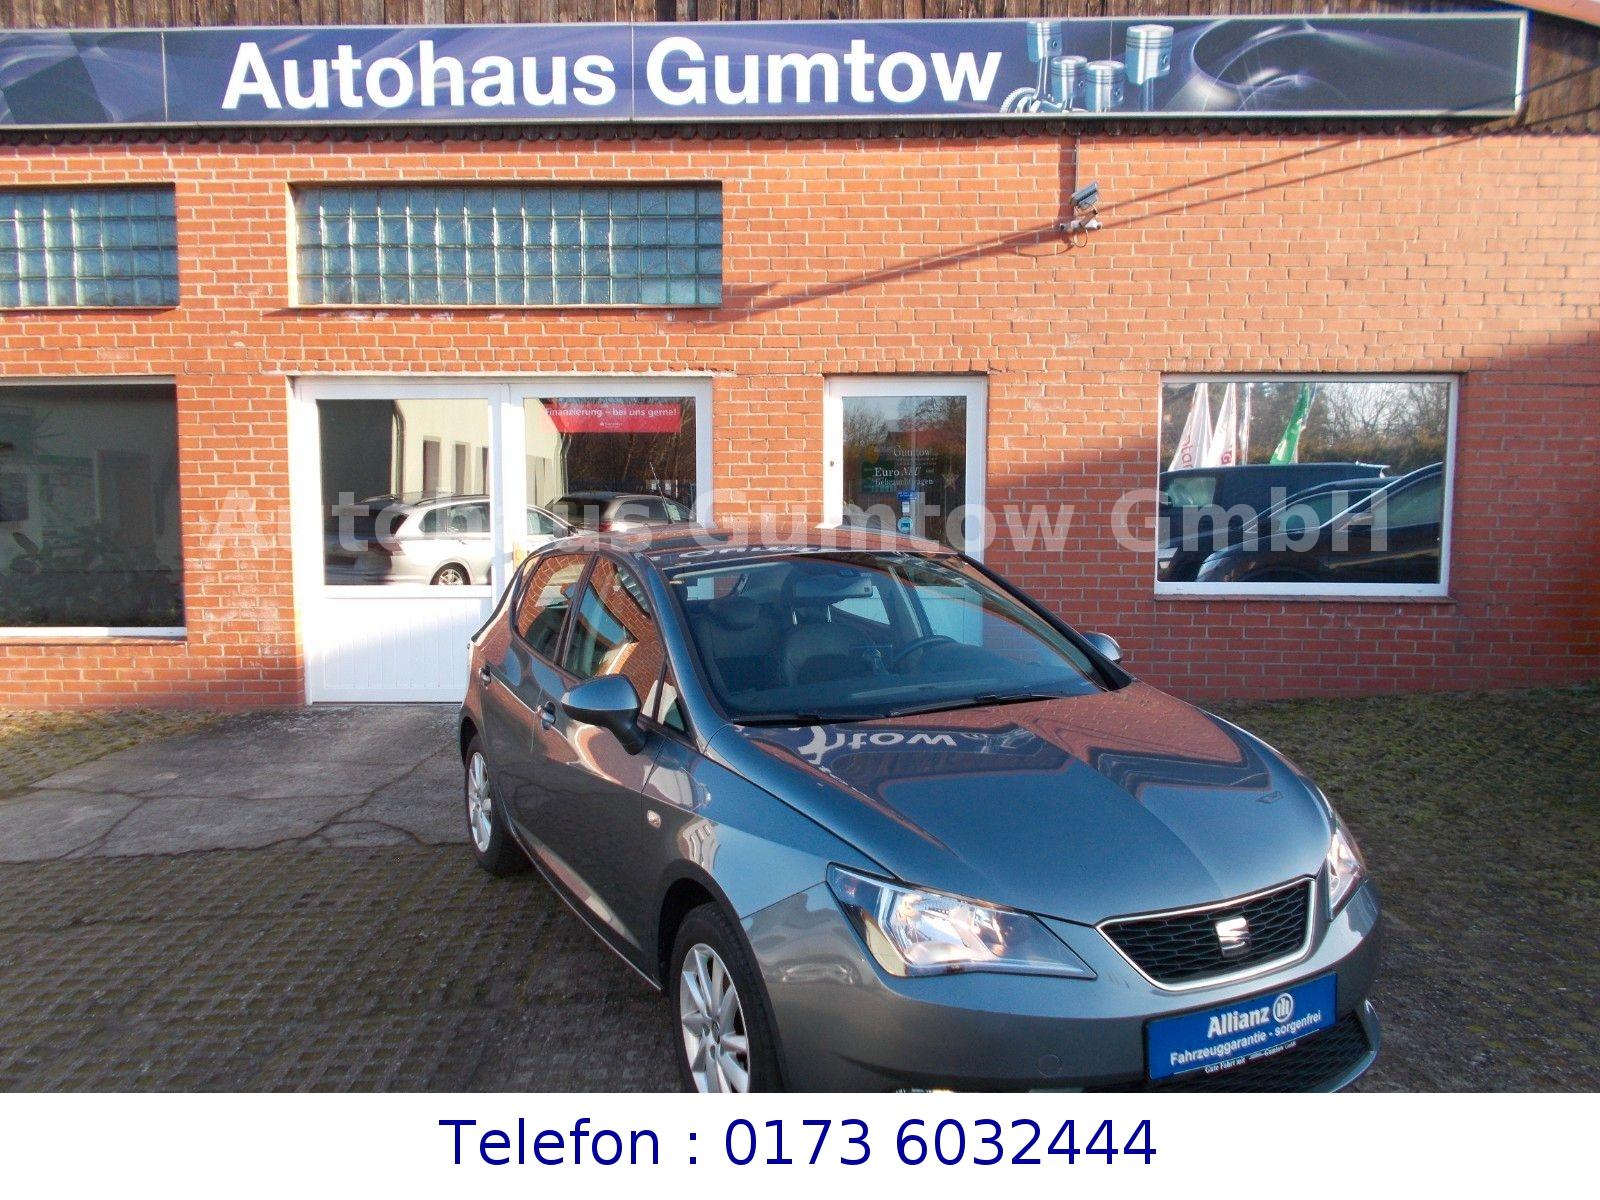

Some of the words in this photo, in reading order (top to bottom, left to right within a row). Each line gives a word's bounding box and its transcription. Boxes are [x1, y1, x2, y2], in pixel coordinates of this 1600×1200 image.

[221, 40, 616, 109] Autohaus
[646, 36, 1002, 105] Gumtow
[612, 407, 626, 416] bei
[629, 408, 644, 416] uns
[875, 467, 900, 477] Euro
[1170, 1031, 1267, 1067] Fahrzeuggarantie
[1275, 1010, 1322, 1037] sorgenfrei
[1207, 1006, 1270, 1039] Allianz
